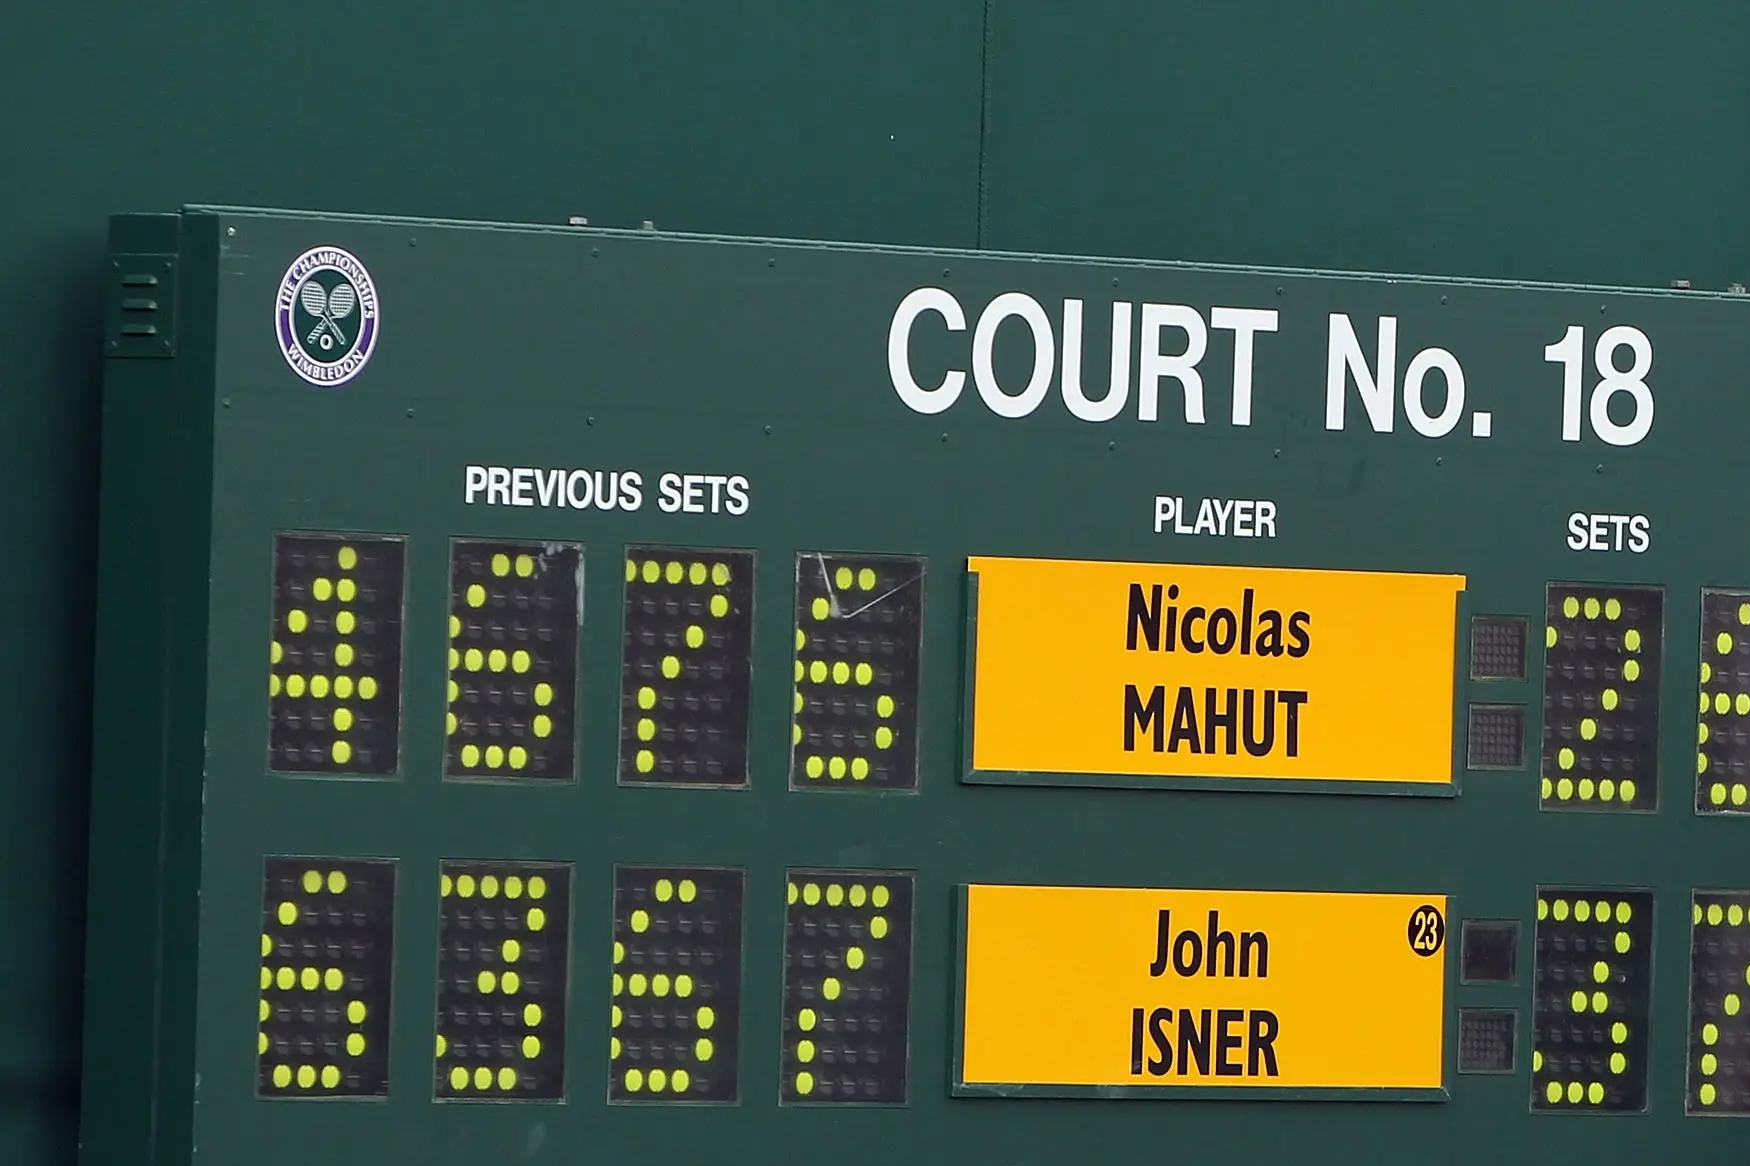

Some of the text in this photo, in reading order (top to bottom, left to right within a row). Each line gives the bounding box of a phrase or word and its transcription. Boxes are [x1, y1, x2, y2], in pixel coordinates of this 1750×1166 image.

[280, 252, 374, 319] THE CHAMPIONSHIPS
[288, 344, 364, 380] WIMBLEDON
[888, 287, 1654, 446] COURT No. 18
[465, 466, 749, 515] PREVIOUS SETS
[1154, 496, 1276, 538] PLAYER
[1567, 513, 1650, 553] SETS
[1126, 583, 1310, 658] Nicolas
[269, 547, 895, 780] 4 6 7 6
[1123, 684, 1308, 757] MAHUT
[1541, 596, 1641, 802] 2
[1150, 909, 1268, 978] John
[1414, 911, 1437, 950] 23
[258, 871, 890, 1095] 6 3 6 7
[1532, 899, 1632, 1104] 3
[1131, 1007, 1279, 1077] ISNER
